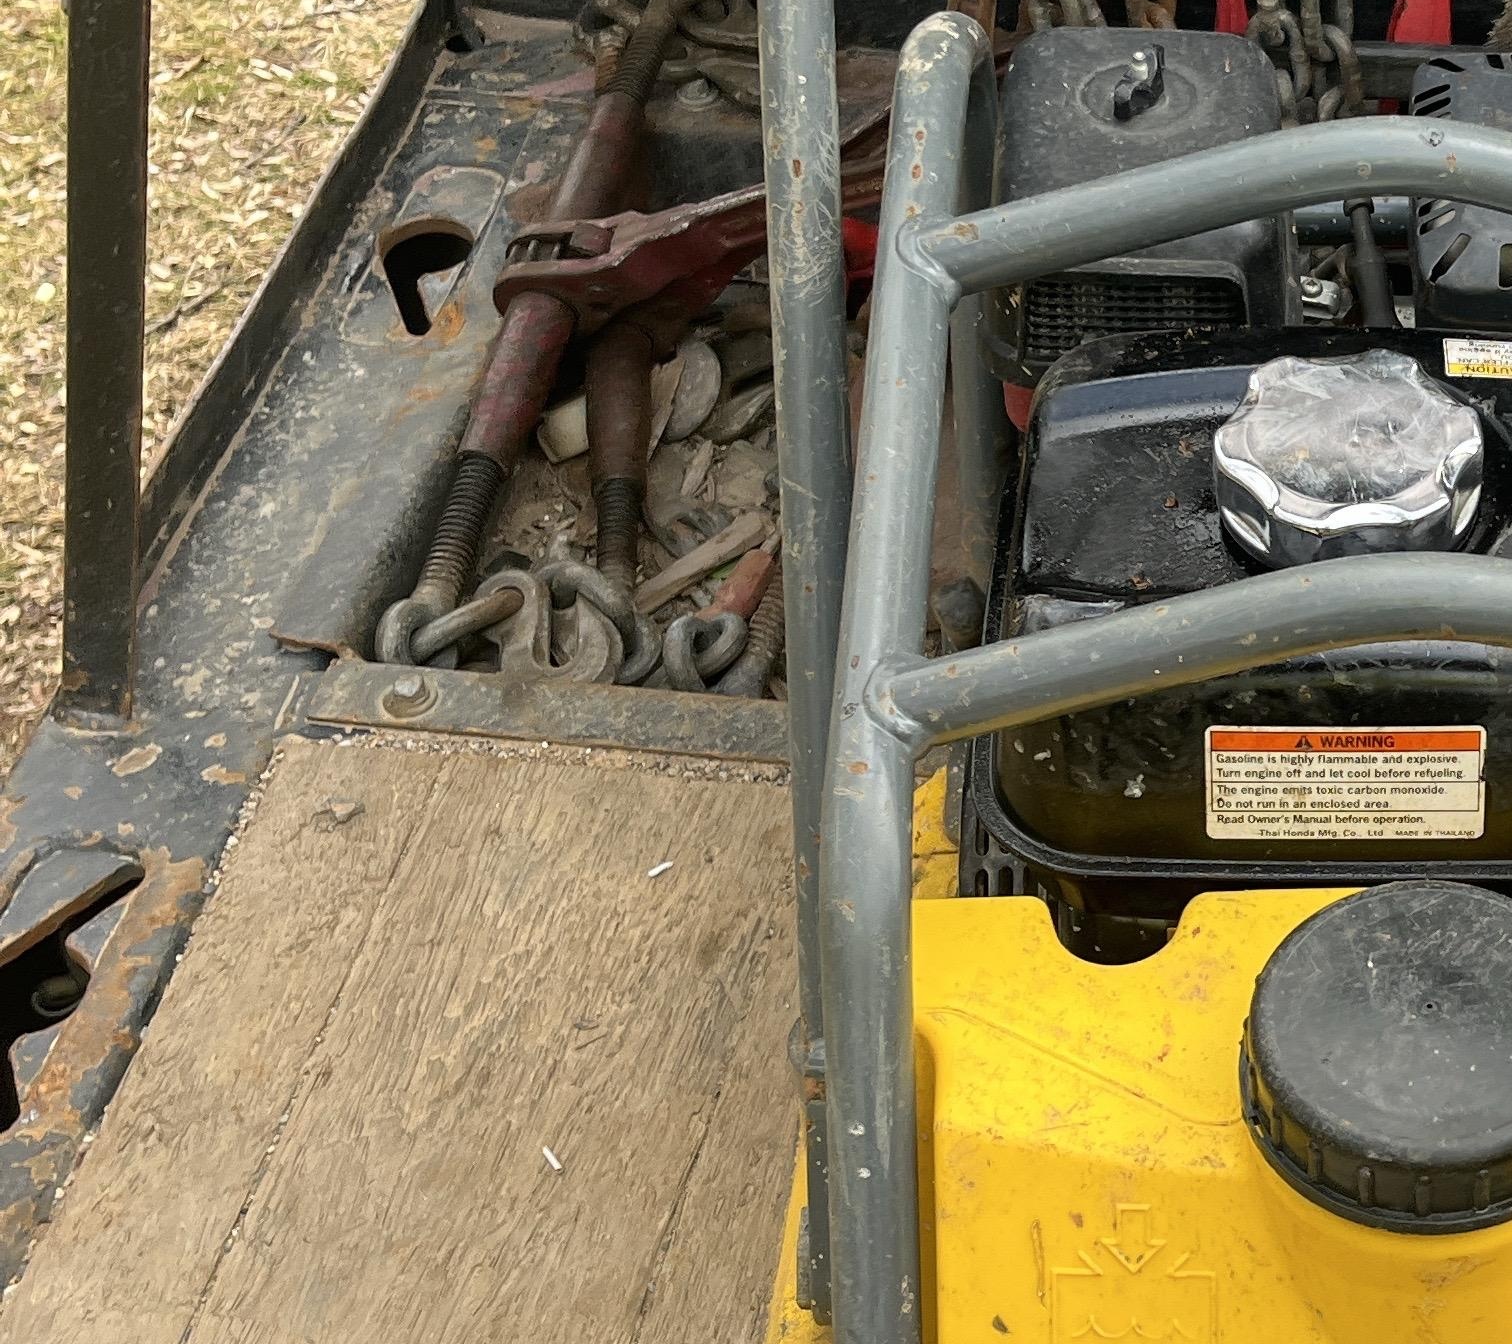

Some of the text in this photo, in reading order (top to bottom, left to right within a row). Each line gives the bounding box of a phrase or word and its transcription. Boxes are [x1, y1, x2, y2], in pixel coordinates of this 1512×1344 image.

[1319, 735, 1396, 748] WARNING
[1216, 754, 1264, 764] Gasoline
[1267, 754, 1277, 764] is
[1280, 754, 1314, 766] highly
[1318, 754, 1379, 764] flammable
[1382, 754, 1403, 764] and
[1216, 768, 1241, 778] Turn
[1244, 768, 1282, 780] engine
[1286, 768, 1302, 778] off
[1305, 768, 1326, 778] and
[1329, 768, 1344, 778] let
[1347, 768, 1371, 778] cool
[1374, 768, 1411, 778] before
[1216, 784, 1238, 795] The
[1240, 785, 1278, 797] engine
[1282, 785, 1313, 795] emits
[1316, 785, 1344, 795] toxic
[1347, 785, 1387, 795] carbon
[1216, 797, 1232, 809] Do
[1235, 799, 1253, 809] not
[1256, 799, 1276, 809] run
[1279, 798, 1289, 809] in
[1292, 799, 1307, 809] an
[1310, 798, 1361, 809] enclosed
[1216, 814, 1426, 826] Read Owner's Manual before operation.
[1259, 828, 1281, 837] Thai
[1283, 828, 1315, 837] Honda
